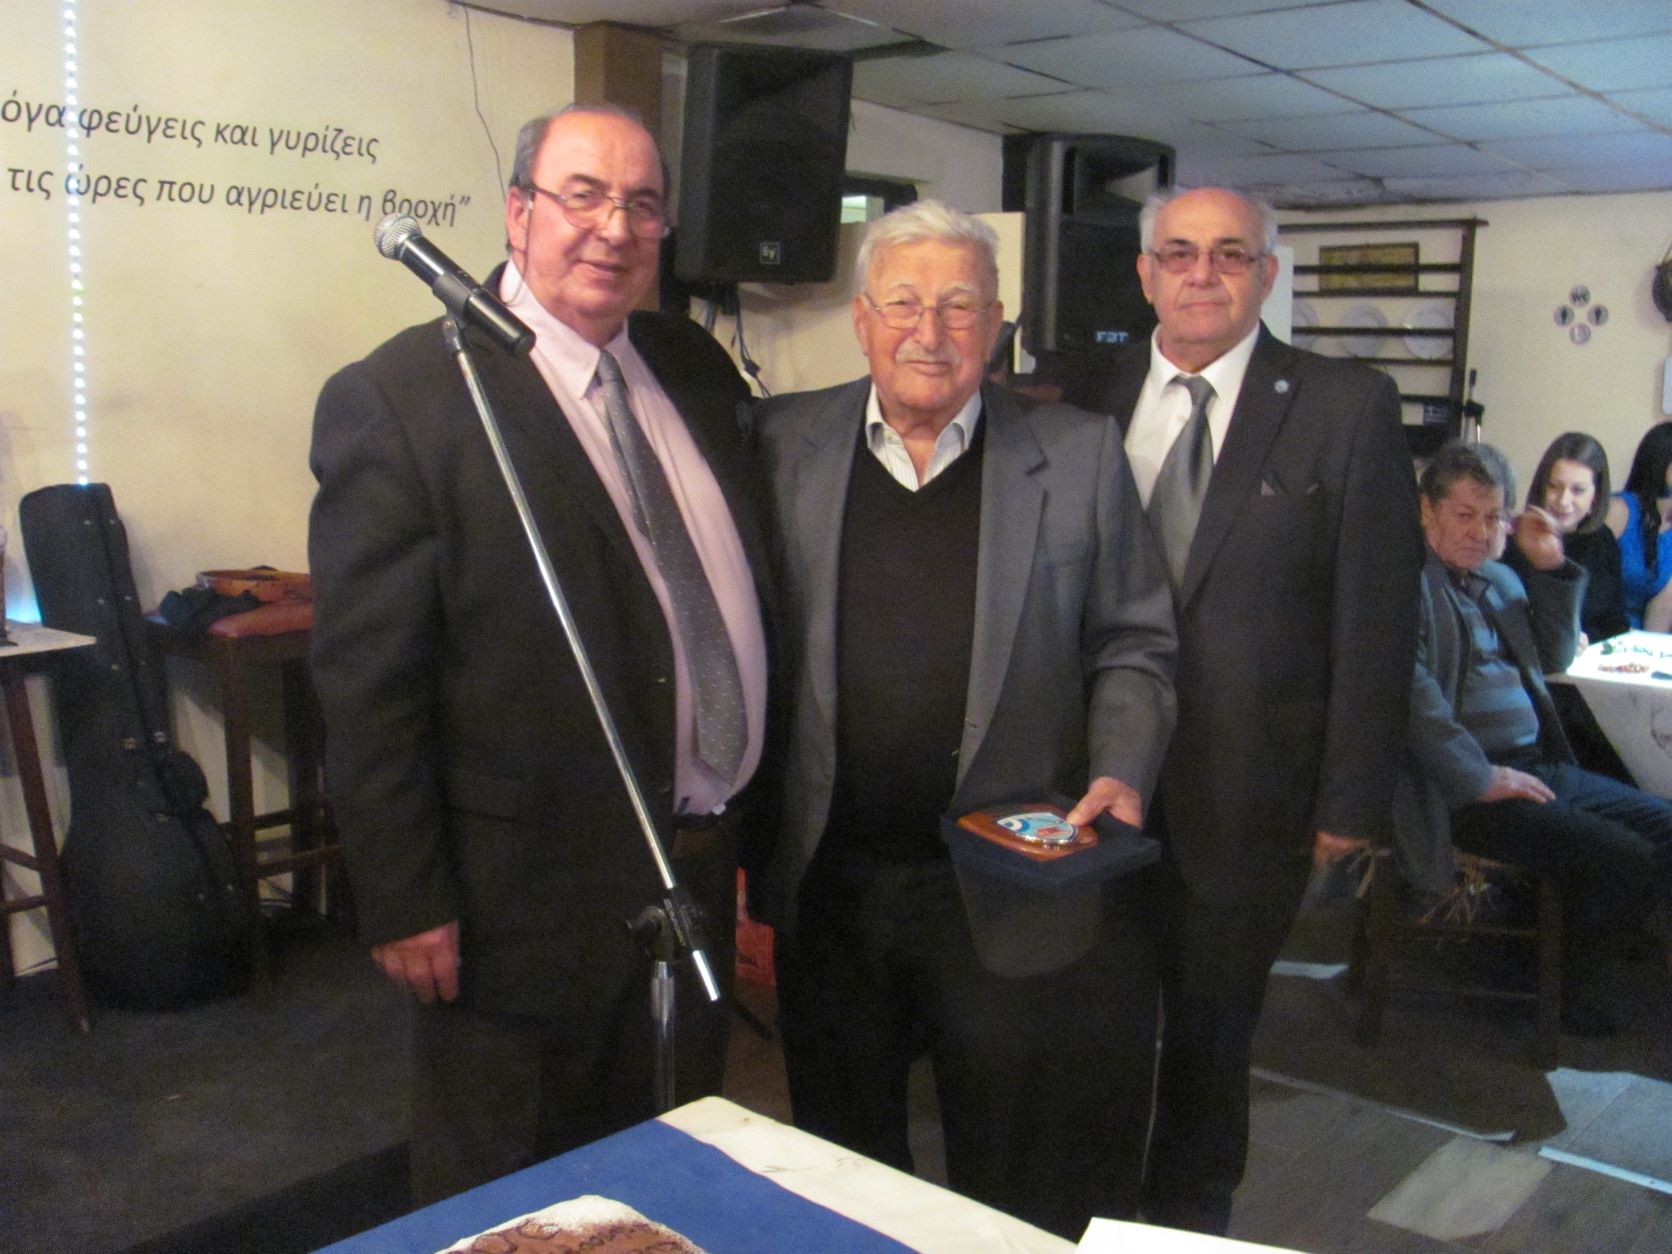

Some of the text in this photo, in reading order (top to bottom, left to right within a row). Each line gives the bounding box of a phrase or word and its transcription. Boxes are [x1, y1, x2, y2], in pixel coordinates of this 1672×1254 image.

[78, 104, 206, 148] φεύγεις
[214, 122, 259, 147] και
[269, 125, 379, 164] γυρίζεις
[7, 167, 54, 200] τις
[64, 163, 148, 206] ώρες
[156, 179, 215, 204] που
[225, 183, 348, 215] αγριεύει
[358, 194, 372, 221] η
